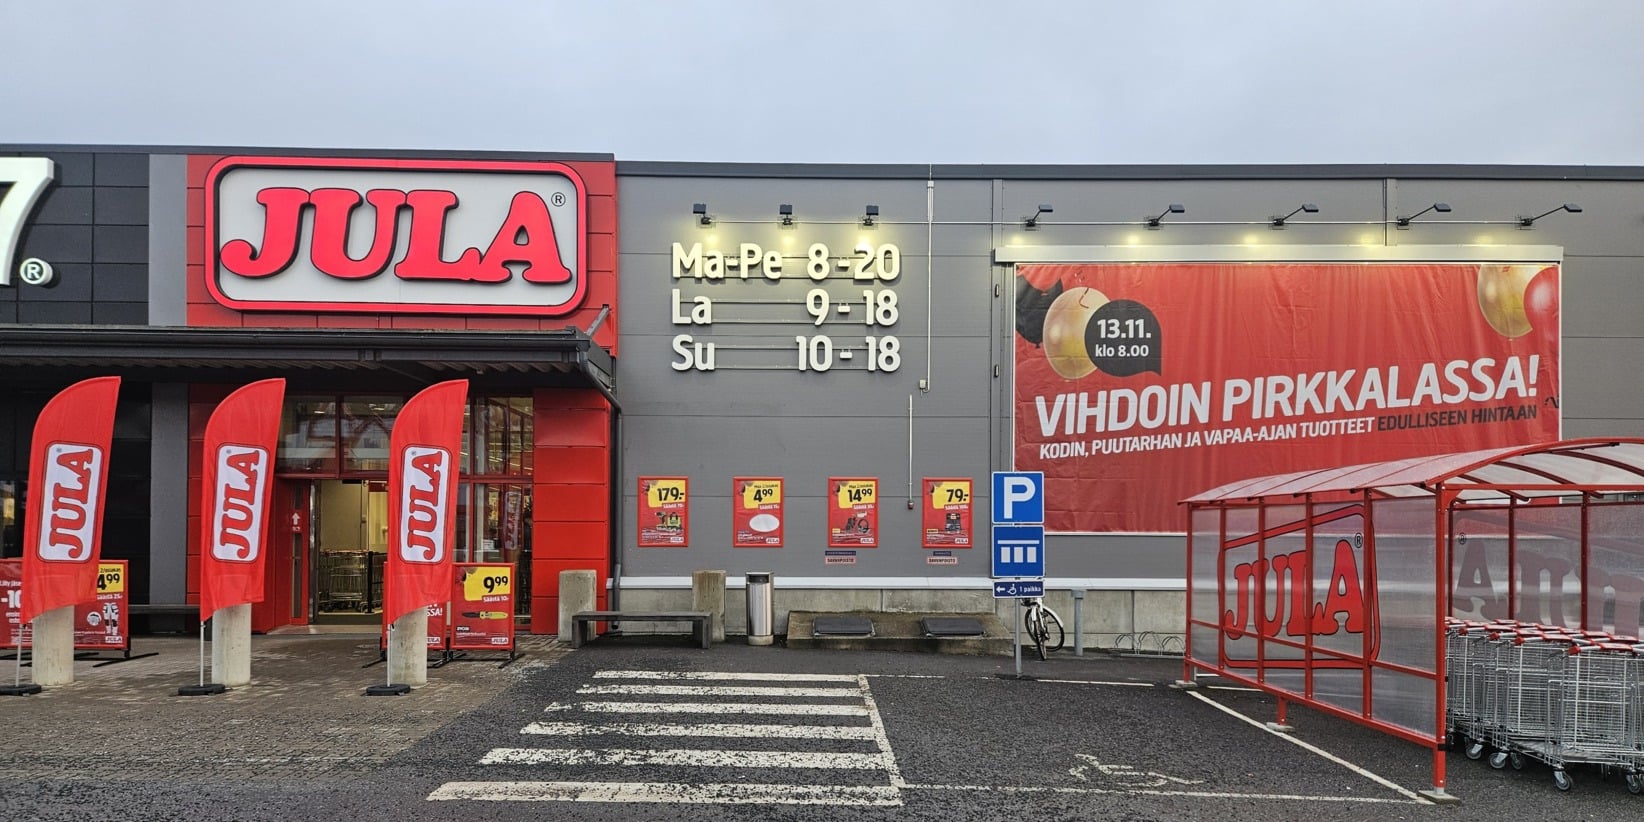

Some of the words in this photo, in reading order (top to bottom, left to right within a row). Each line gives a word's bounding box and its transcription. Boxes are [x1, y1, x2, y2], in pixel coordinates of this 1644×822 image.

[219, 187, 573, 284] JULA
[672, 242, 783, 280] Ma-Pe
[807, 243, 830, 280] 8
[672, 289, 713, 324] La
[806, 289, 830, 325] 9
[863, 289, 899, 326] 18
[1097, 318, 1152, 339] 13.11.
[671, 334, 715, 371] Su
[796, 335, 833, 372] 10
[865, 335, 901, 372] 18
[1095, 344, 1115, 357] klo
[1118, 344, 1149, 357] 8.00
[1035, 381, 1212, 437] VIHDOIN
[1222, 354, 1540, 422] PIRKKALASSA!
[1039, 440, 1089, 460] KODIN,
[1092, 432, 1182, 456] PUUTARHAN
[1184, 431, 1201, 448] JA
[1204, 423, 1297, 446] VAPAA-AJAN
[1300, 416, 1375, 437] TUOTTEET
[1377, 409, 1467, 432] EDULLISEEN
[1471, 404, 1537, 424] HINTAAN
[49, 448, 93, 559] JULA
[219, 450, 260, 559] JULA
[407, 450, 443, 560] JULA
[1003, 476, 1036, 519] P
[1024, 584, 1042, 593] paikka
